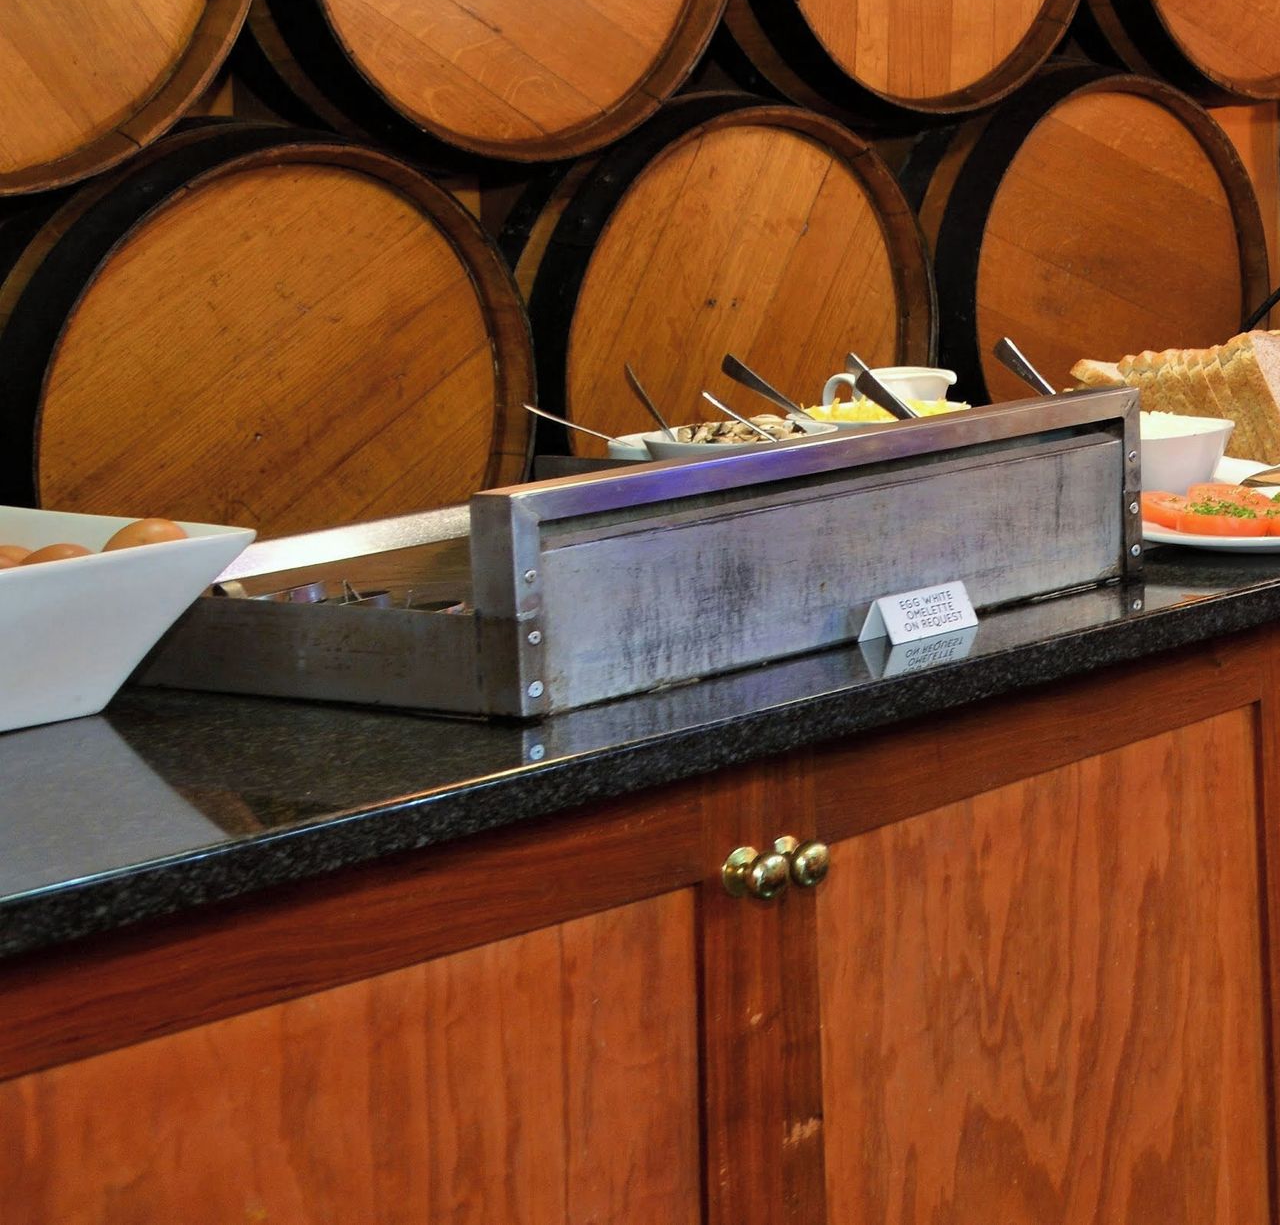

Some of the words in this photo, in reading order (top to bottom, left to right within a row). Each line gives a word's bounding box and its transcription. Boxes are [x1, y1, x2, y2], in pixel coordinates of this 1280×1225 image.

[899, 597, 920, 610] EGG
[922, 590, 953, 604] WHITE
[906, 601, 954, 620] OMELETTE
[904, 622, 920, 632] ON
[921, 611, 963, 628] REQUEST
